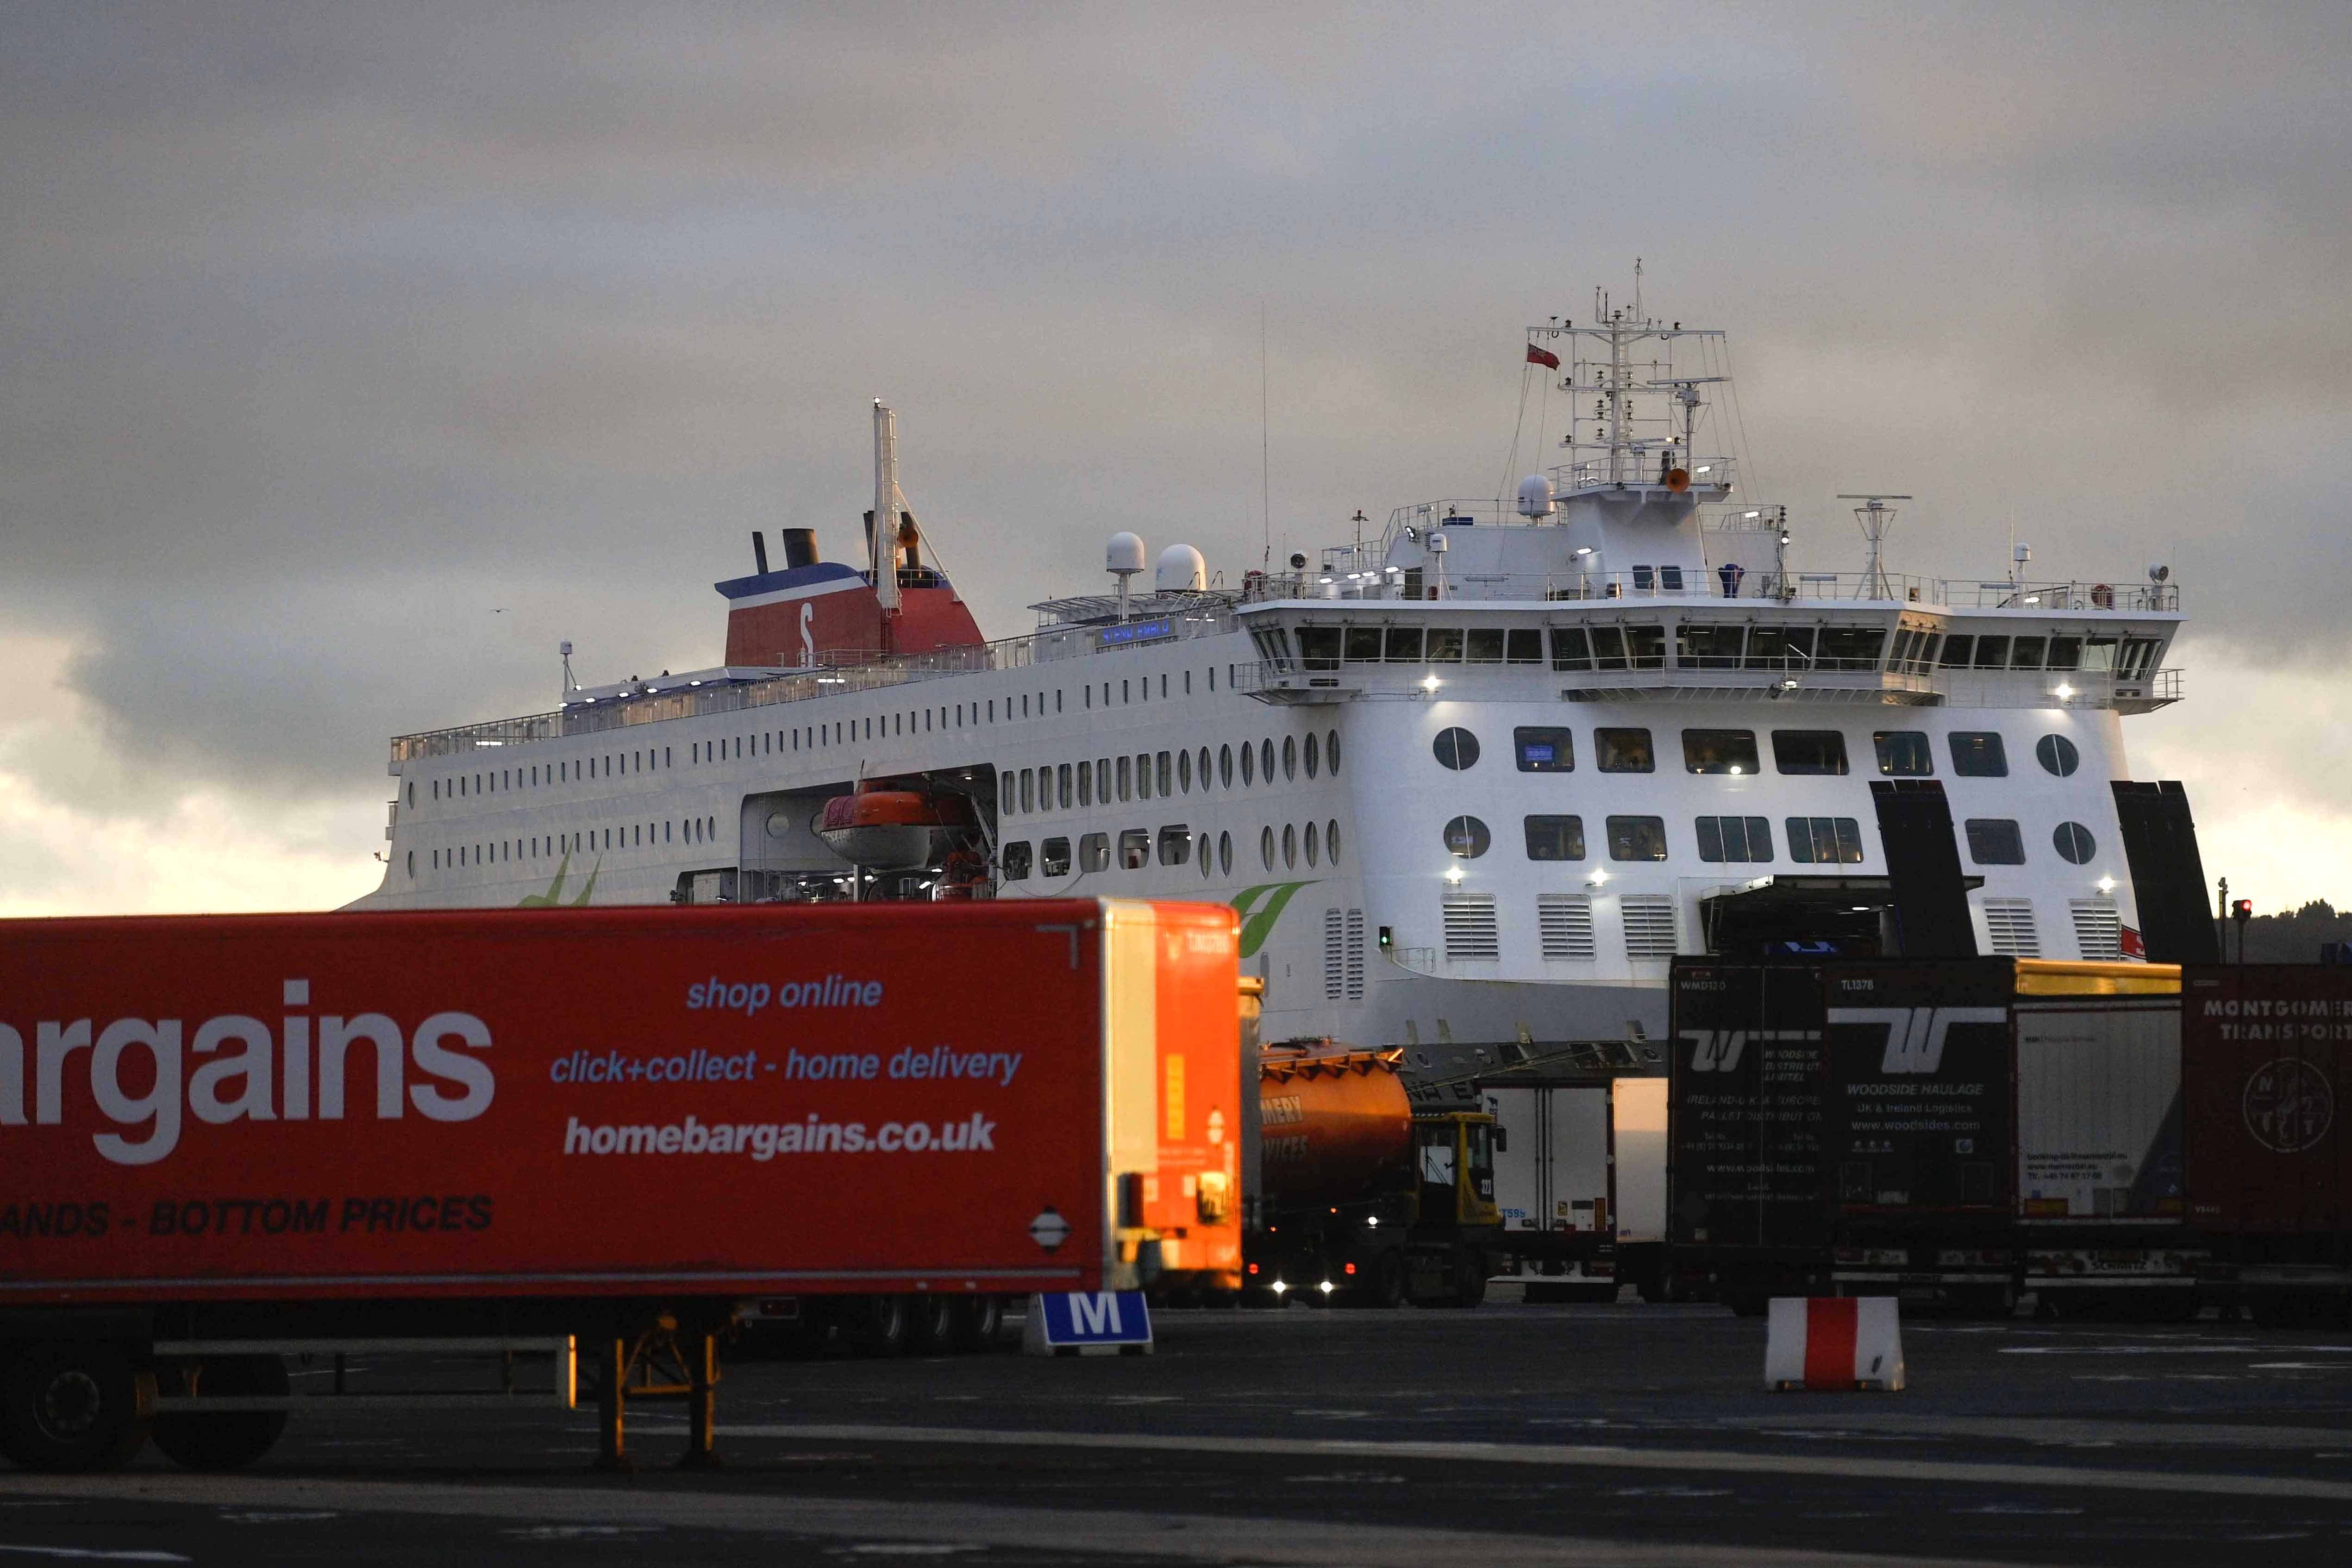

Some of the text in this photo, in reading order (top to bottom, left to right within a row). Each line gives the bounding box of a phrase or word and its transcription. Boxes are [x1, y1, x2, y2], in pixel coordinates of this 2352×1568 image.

[687, 974, 883, 1015] shop online
[550, 1049, 757, 1083] click+collect
[785, 1048, 880, 1080] home
[888, 1045, 1022, 1087] delivery
[1847, 1084, 1983, 1096] WOODSIDE HAULAGE
[1887, 1103, 1922, 1112] Ireland
[1926, 1103, 1973, 1114] Logistics
[564, 1112, 995, 1162] homebargains.co.uk
[1852, 1120, 1981, 1131] www.woodsides.com
[149, 1198, 329, 1236] BOTTOM
[340, 1194, 494, 1232] PRICES
[1069, 1291, 1122, 1334] M
